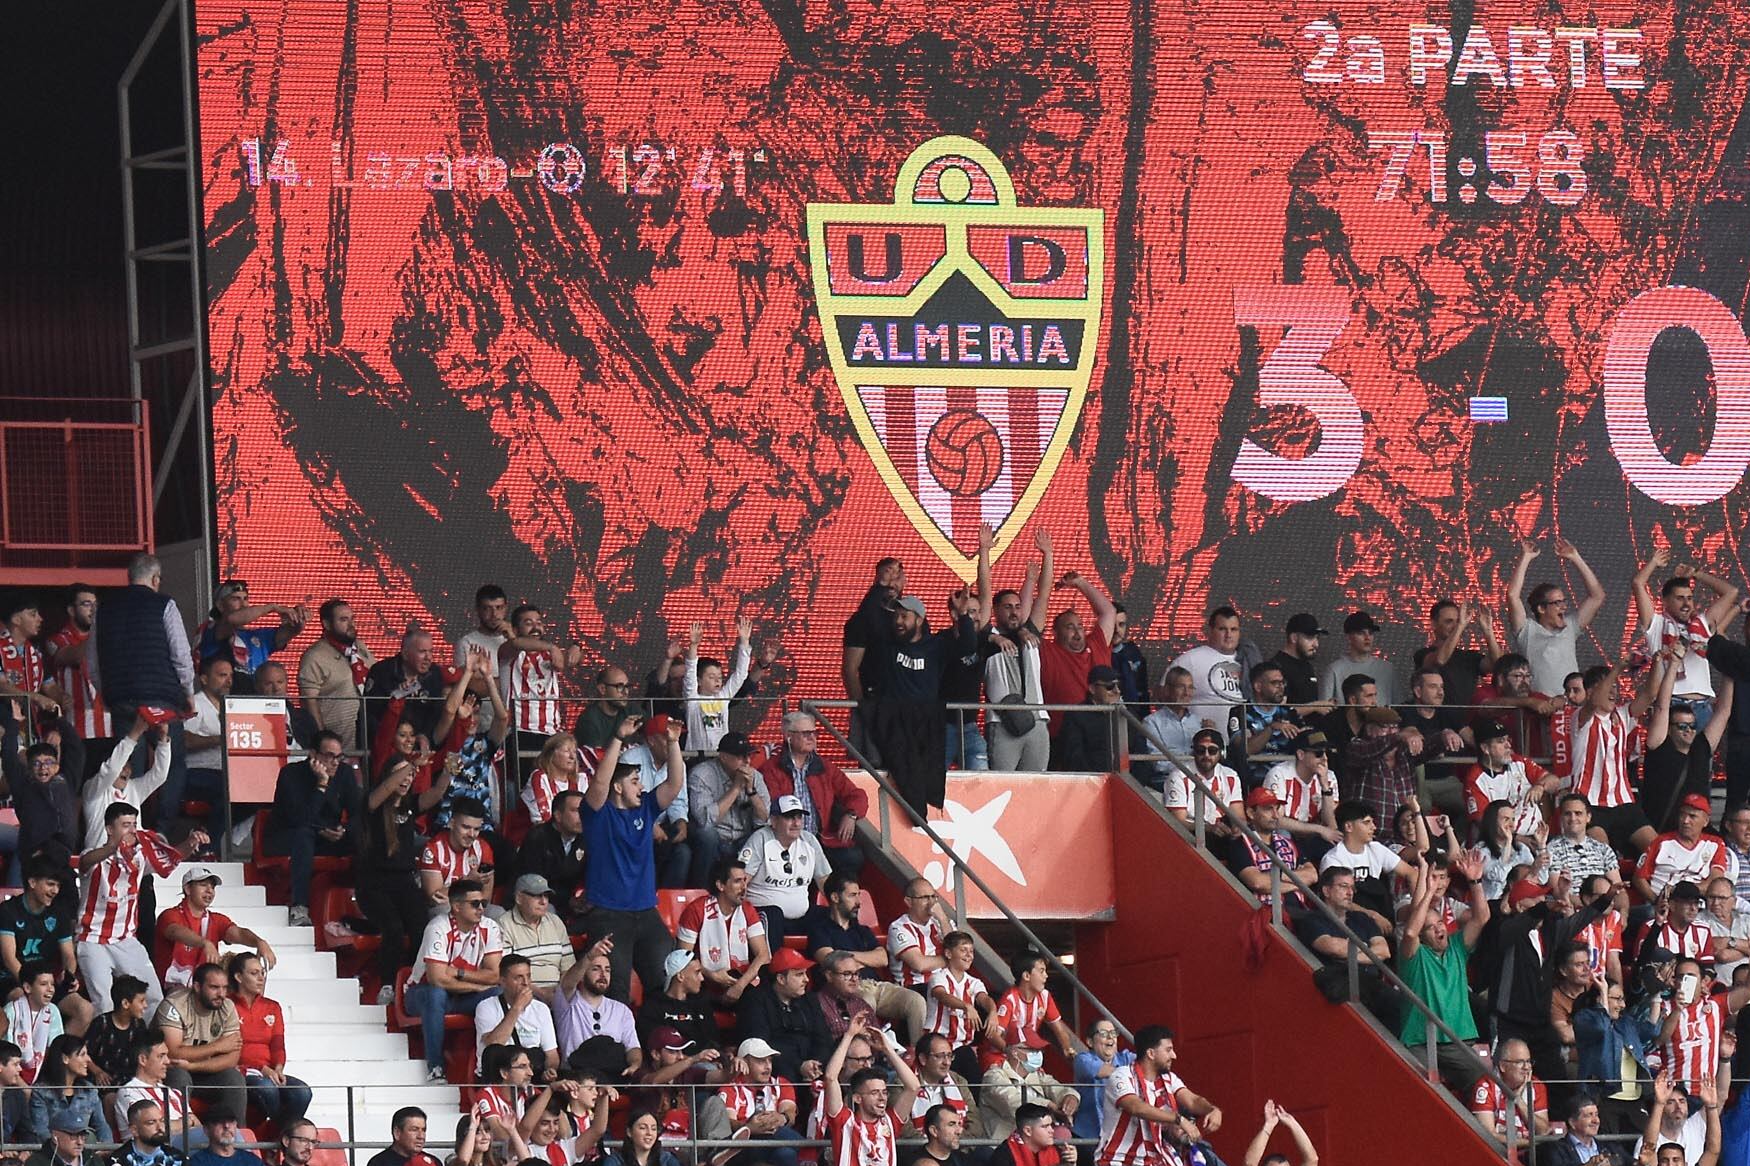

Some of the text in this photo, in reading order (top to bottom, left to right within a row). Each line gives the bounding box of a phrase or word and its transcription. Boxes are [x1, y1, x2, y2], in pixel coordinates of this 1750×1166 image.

[1409, 23, 1646, 89] PARTE
[1367, 130, 1588, 206] 71:58
[847, 233, 1067, 286] U D
[852, 321, 1070, 363] ALMERIA
[1230, 285, 1364, 502] 3
[229, 721, 255, 731] Sector
[229, 731, 262, 749] 135
